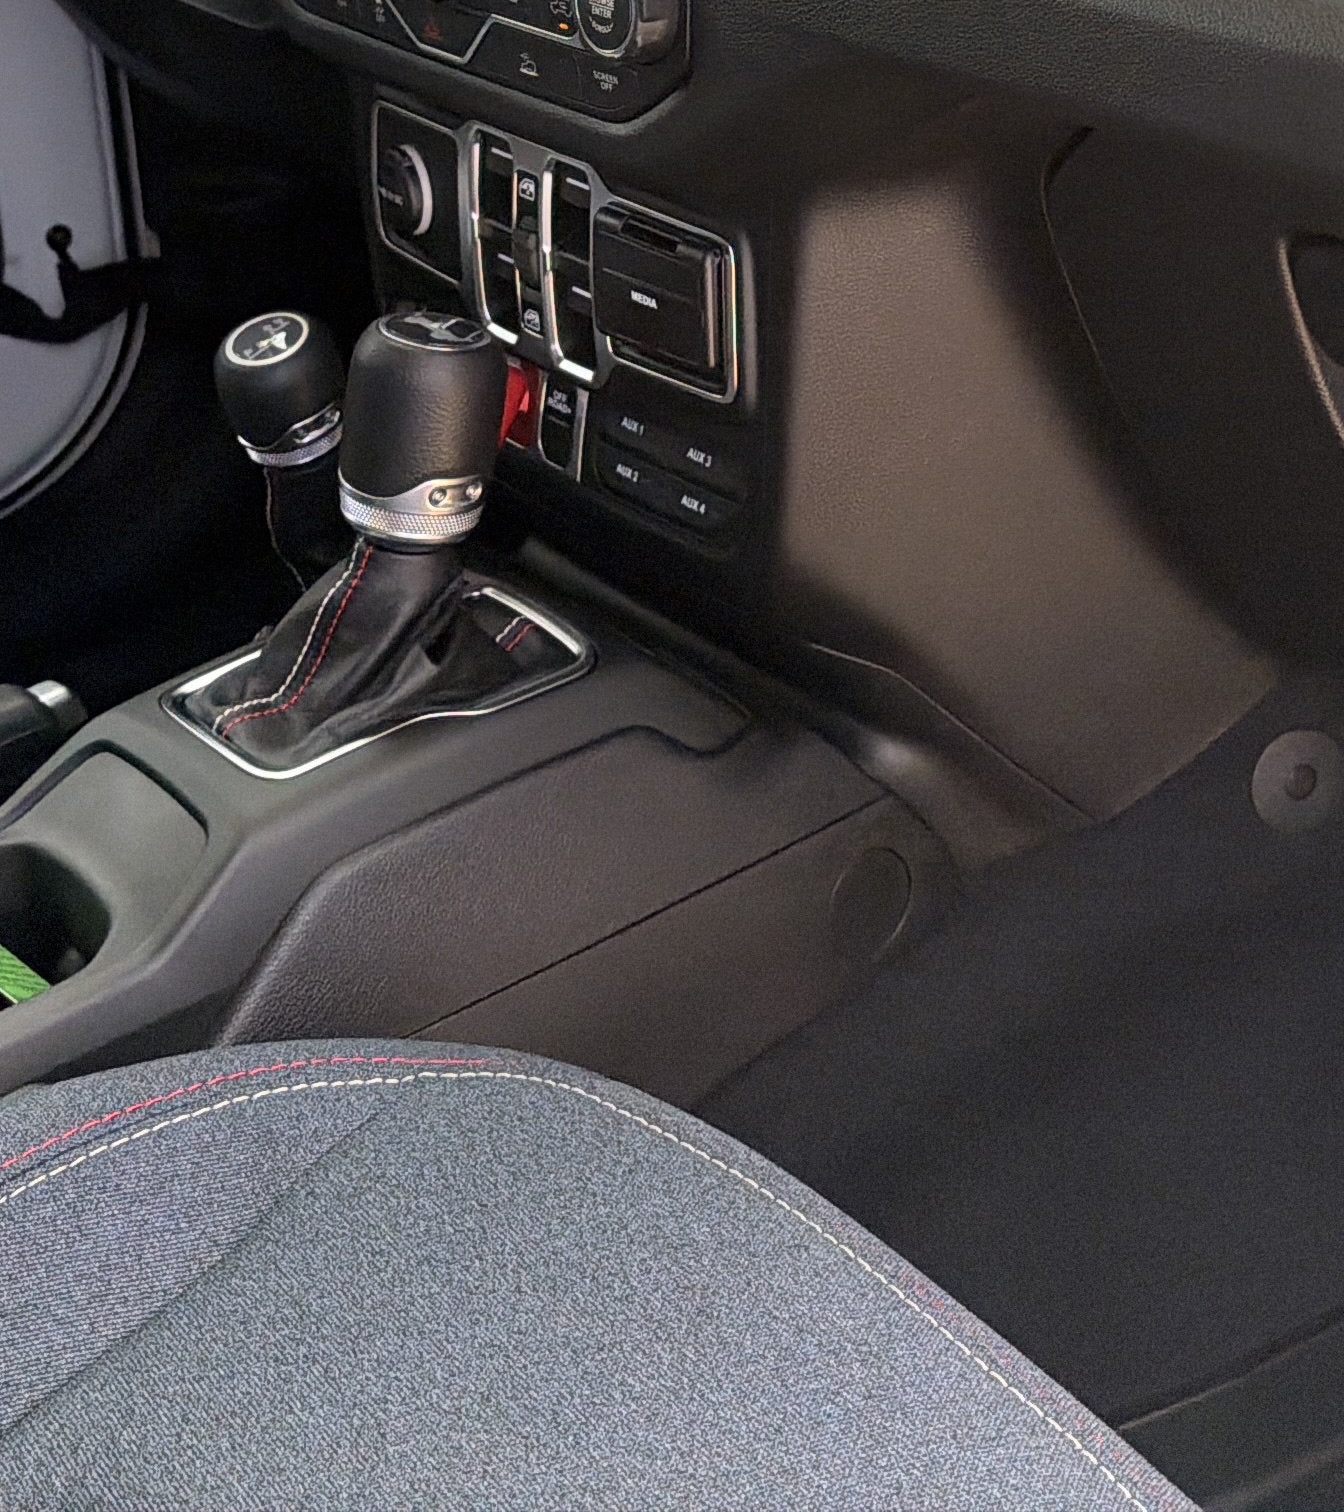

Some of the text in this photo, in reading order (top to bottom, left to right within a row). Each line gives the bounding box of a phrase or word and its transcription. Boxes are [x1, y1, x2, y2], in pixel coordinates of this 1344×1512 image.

[593, 69, 619, 86] SCREEN
[630, 289, 658, 310] MEDIA
[620, 416, 638, 432] AUX
[686, 447, 705, 464] AUX
[616, 463, 632, 479] AUX
[680, 494, 698, 512] AUX
